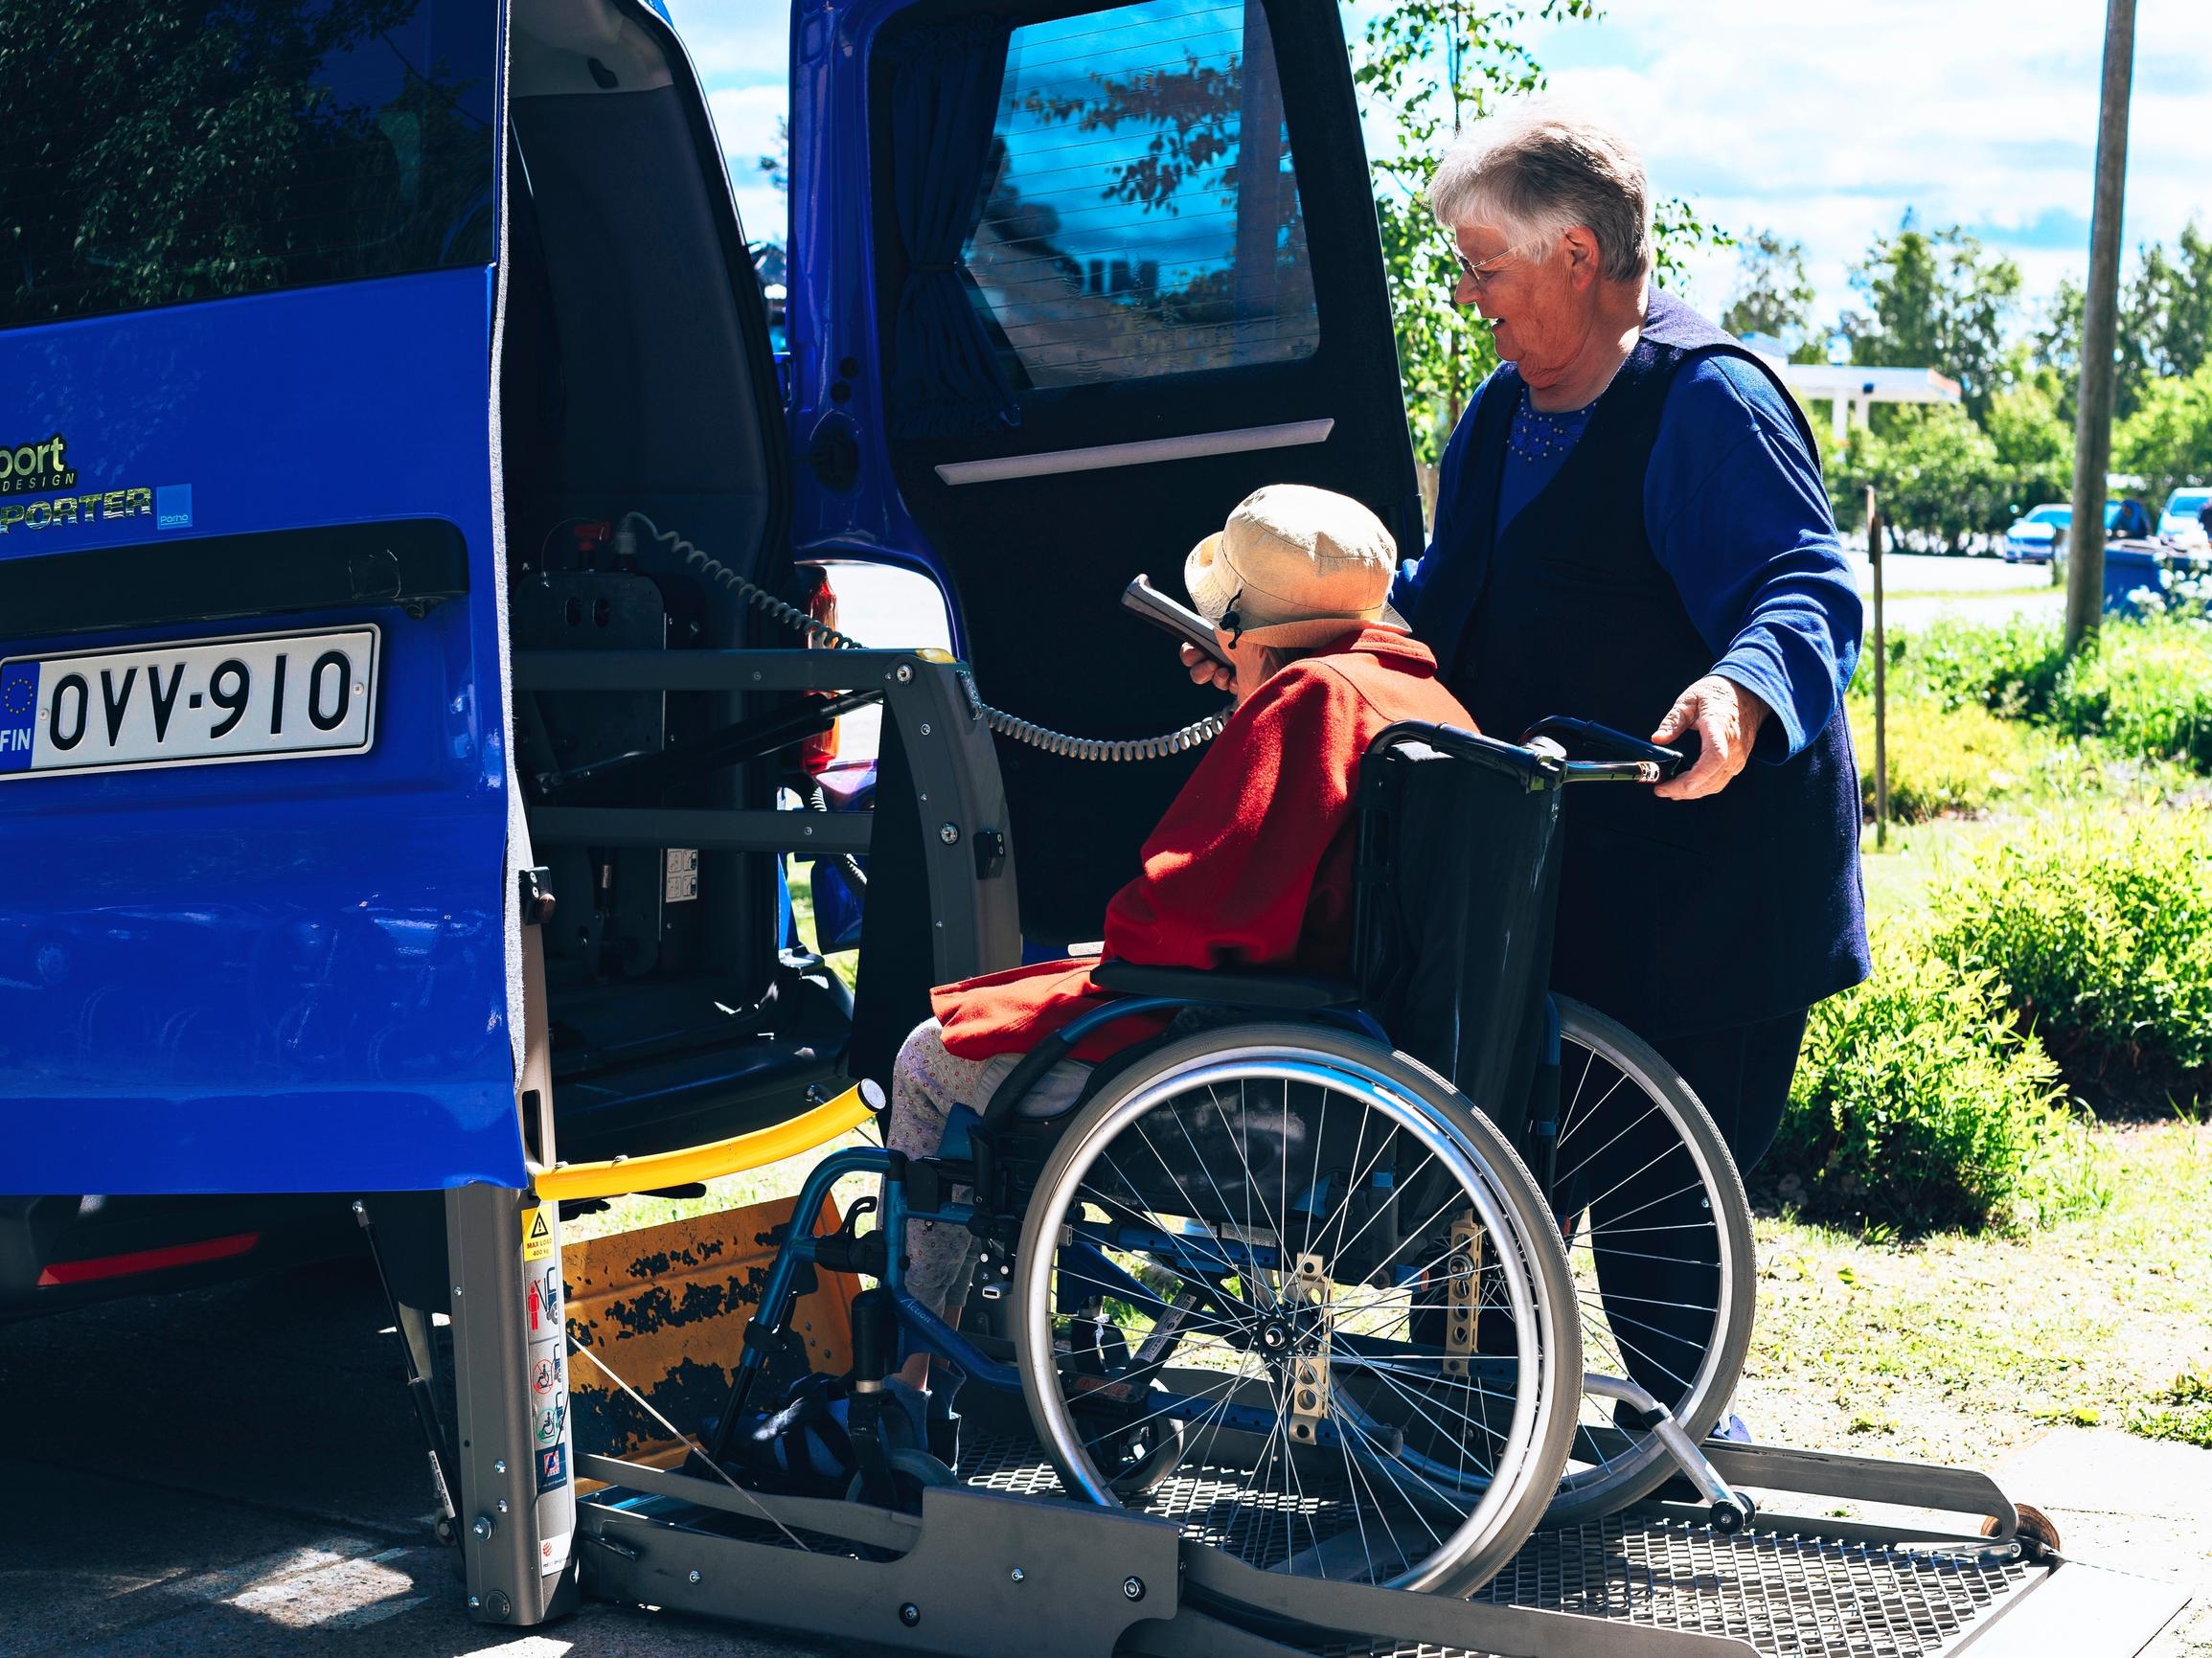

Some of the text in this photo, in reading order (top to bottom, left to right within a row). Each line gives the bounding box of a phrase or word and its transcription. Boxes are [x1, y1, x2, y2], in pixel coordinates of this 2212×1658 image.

[2, 473, 75, 491] DESIGN
[49, 649, 352, 751] OVV-910
[0, 728, 31, 752] FIN
